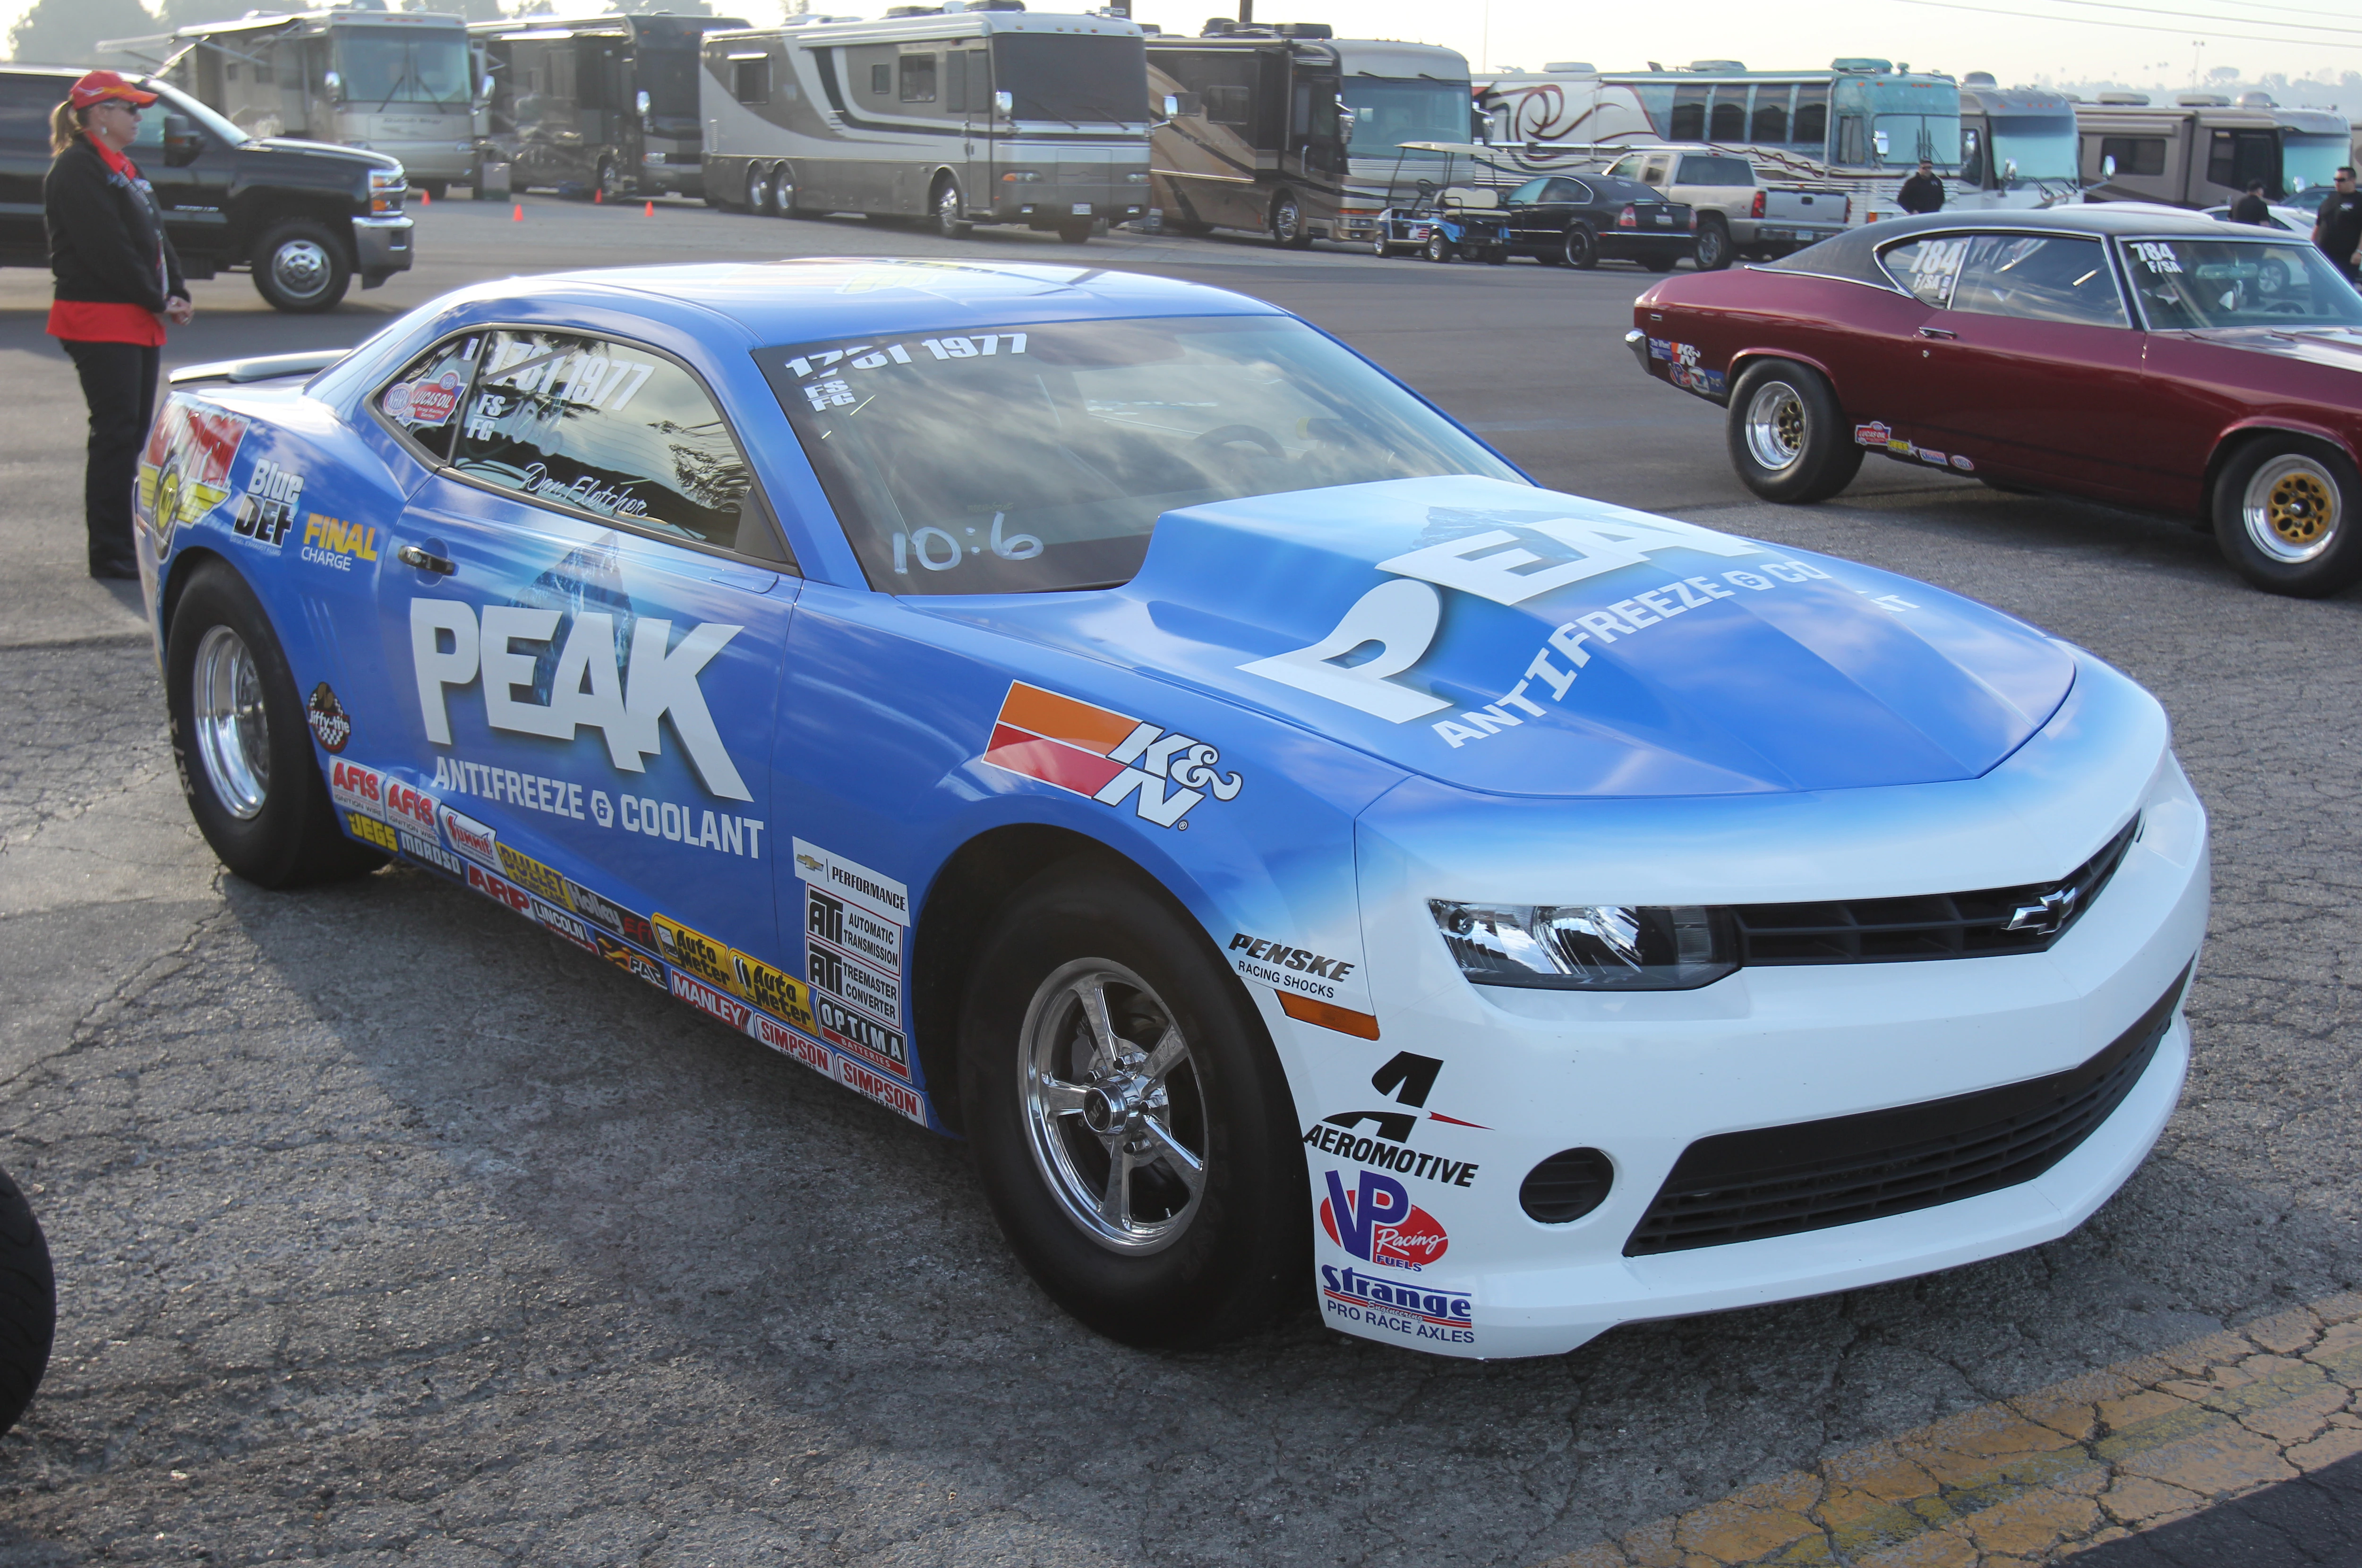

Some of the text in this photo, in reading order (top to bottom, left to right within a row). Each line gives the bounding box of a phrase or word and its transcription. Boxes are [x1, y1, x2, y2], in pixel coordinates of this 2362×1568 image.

[1909, 240, 1964, 275] 784
[2129, 242, 2176, 262] 784
[921, 333, 1027, 360] 1977
[389, 388, 411, 410] NHRA
[411, 391, 454, 409] LUCAS OIL
[561, 354, 655, 411] 1977
[804, 380, 849, 399] FS
[811, 392, 856, 412] FG
[428, 407, 445, 416] Racing
[476, 393, 506, 417] FS
[466, 418, 496, 442] FG
[247, 458, 305, 504] Blue
[521, 462, 648, 518] Dan Fletcher
[231, 493, 295, 549] DEF
[303, 512, 378, 562] FINAL
[300, 546, 352, 571] CHARGE
[1431, 576, 1735, 749] ANTIFREEZE
[411, 597, 755, 803] PEAK
[309, 710, 351, 733] Jiffy-tite
[334, 793, 364, 810] IGNITION
[366, 804, 383, 817] WIRE
[430, 756, 585, 821] ANTIFREEZE
[620, 794, 764, 859] COOLANT
[350, 813, 399, 852] JEGS
[389, 814, 419, 833] IGNITION
[420, 828, 438, 842] WIRE
[401, 831, 462, 875] MOROSO
[499, 844, 566, 897] BULLET
[469, 864, 531, 912] ARP
[832, 866, 906, 912] PERFORMANCE
[534, 901, 585, 941] LINCOLN
[567, 881, 625, 936] Holley
[624, 917, 652, 944] EFI
[848, 912, 894, 945] AUTOMATIC
[676, 929, 717, 964] Auto
[678, 947, 731, 985] Meter
[843, 929, 898, 967] TRANSMISSION
[1228, 933, 1355, 983] PENSKE
[753, 965, 797, 1004] Auto
[843, 962, 897, 1001] TREEMASTER
[1238, 960, 1335, 999] RACING SHOCKS
[673, 973, 742, 1026] MANLEY
[754, 984, 811, 1025] Meter
[846, 983, 896, 1020] CONVERTER
[761, 1021, 830, 1071] SIMPSON
[821, 1003, 902, 1061] OPTIMA
[841, 1038, 891, 1068] BATTERIES
[843, 1062, 917, 1116] SIMPSON
[1303, 1125, 1480, 1188] AEROMOTIVE
[1325, 1169, 1410, 1262] VP
[1376, 1228, 1449, 1256] Racing
[1376, 1254, 1422, 1272] FUELS
[1321, 1263, 1472, 1318] Strange
[1327, 1299, 1475, 1344] PRO RACE AXLES
[1366, 1300, 1424, 1323] Engineering
